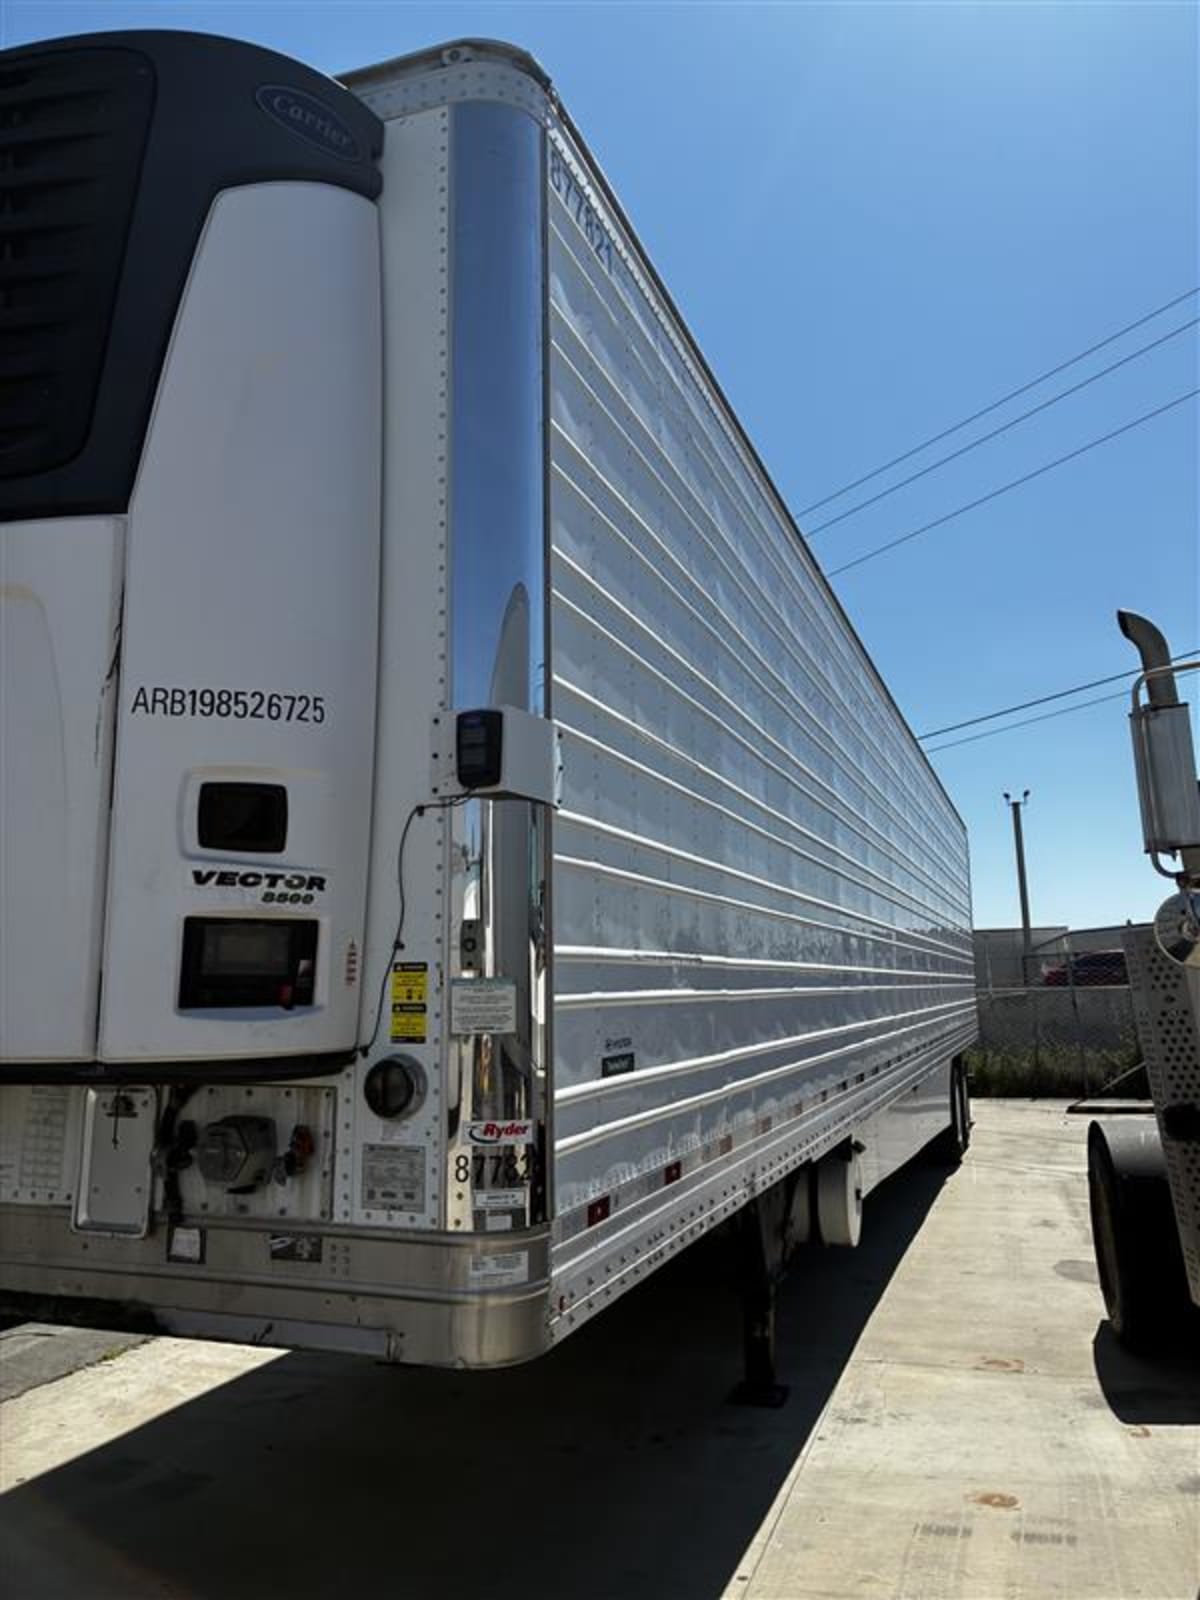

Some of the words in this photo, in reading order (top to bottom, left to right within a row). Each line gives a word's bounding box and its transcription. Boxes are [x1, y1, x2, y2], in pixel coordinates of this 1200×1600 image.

[272, 94, 352, 147] Carrier
[131, 686, 325, 724] ARB198526725
[192, 870, 327, 892] VECTOR
[483, 1121, 529, 1138] Ryder
[455, 1152, 537, 1183] 87782
